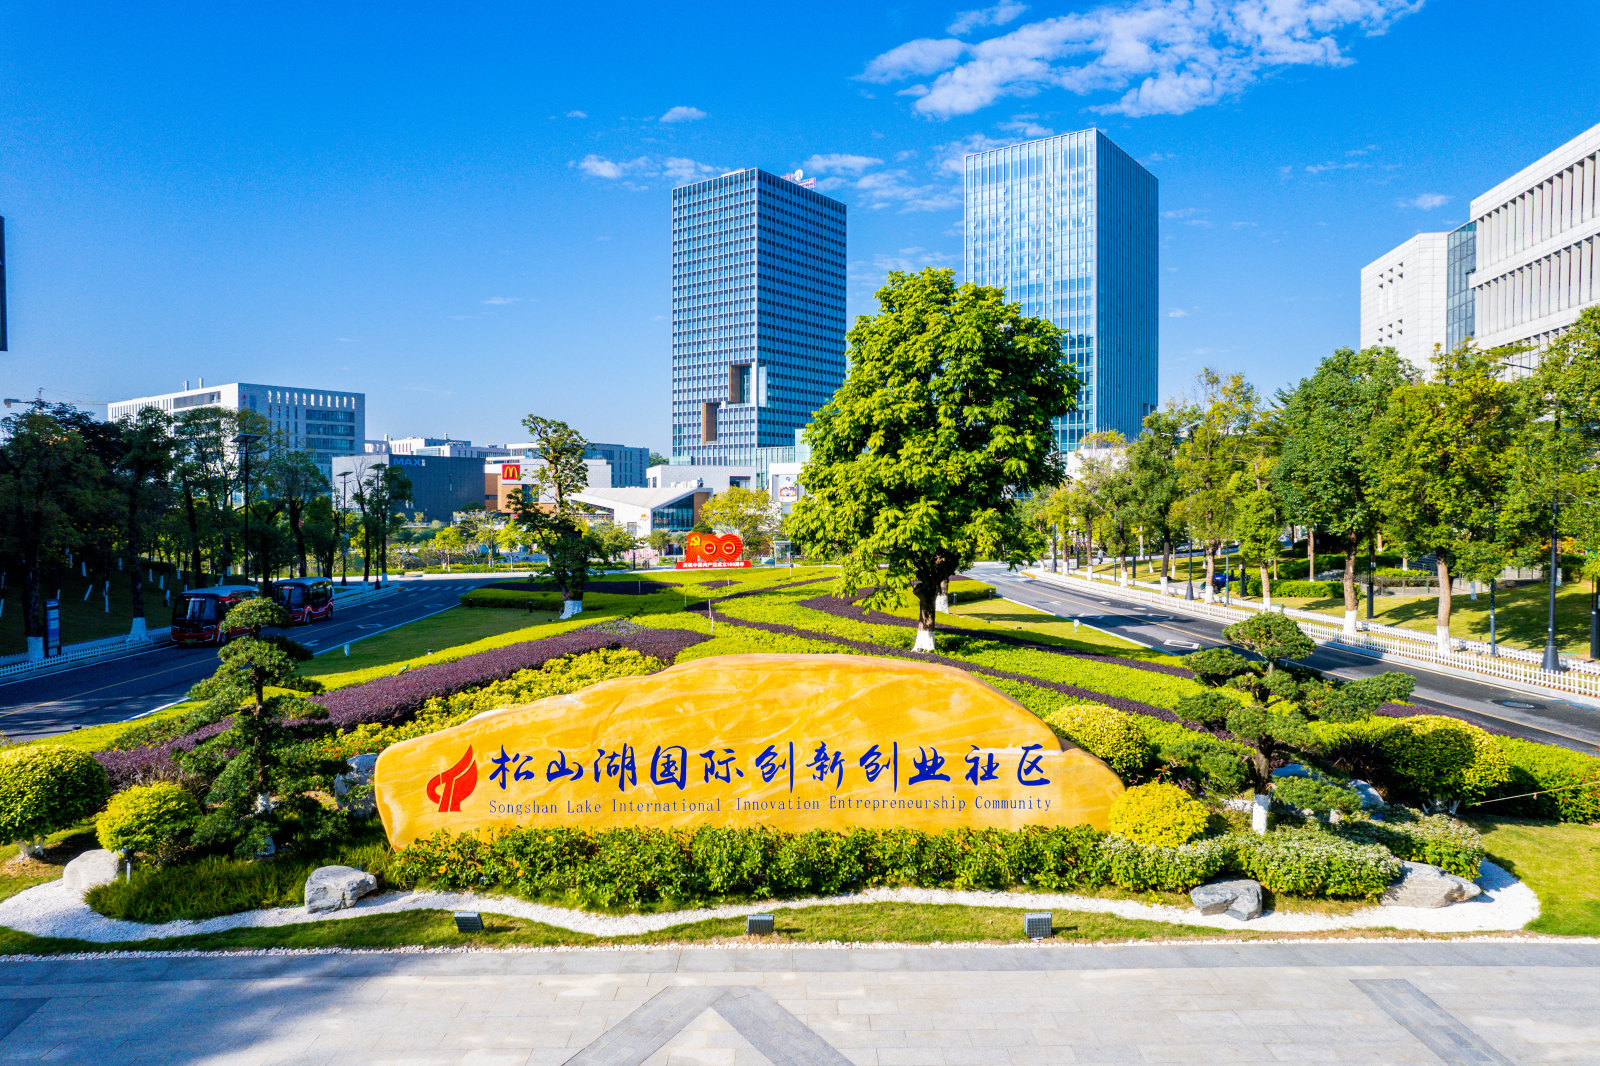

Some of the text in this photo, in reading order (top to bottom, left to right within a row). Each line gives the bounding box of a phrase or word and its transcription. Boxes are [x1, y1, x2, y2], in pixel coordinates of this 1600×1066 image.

[393, 458, 421, 466] MAX
[489, 741, 1051, 793] 松山湖国际创新创业社区
[489, 795, 1051, 816] Songshan Lake International Innovation Entrepreneurship Community
